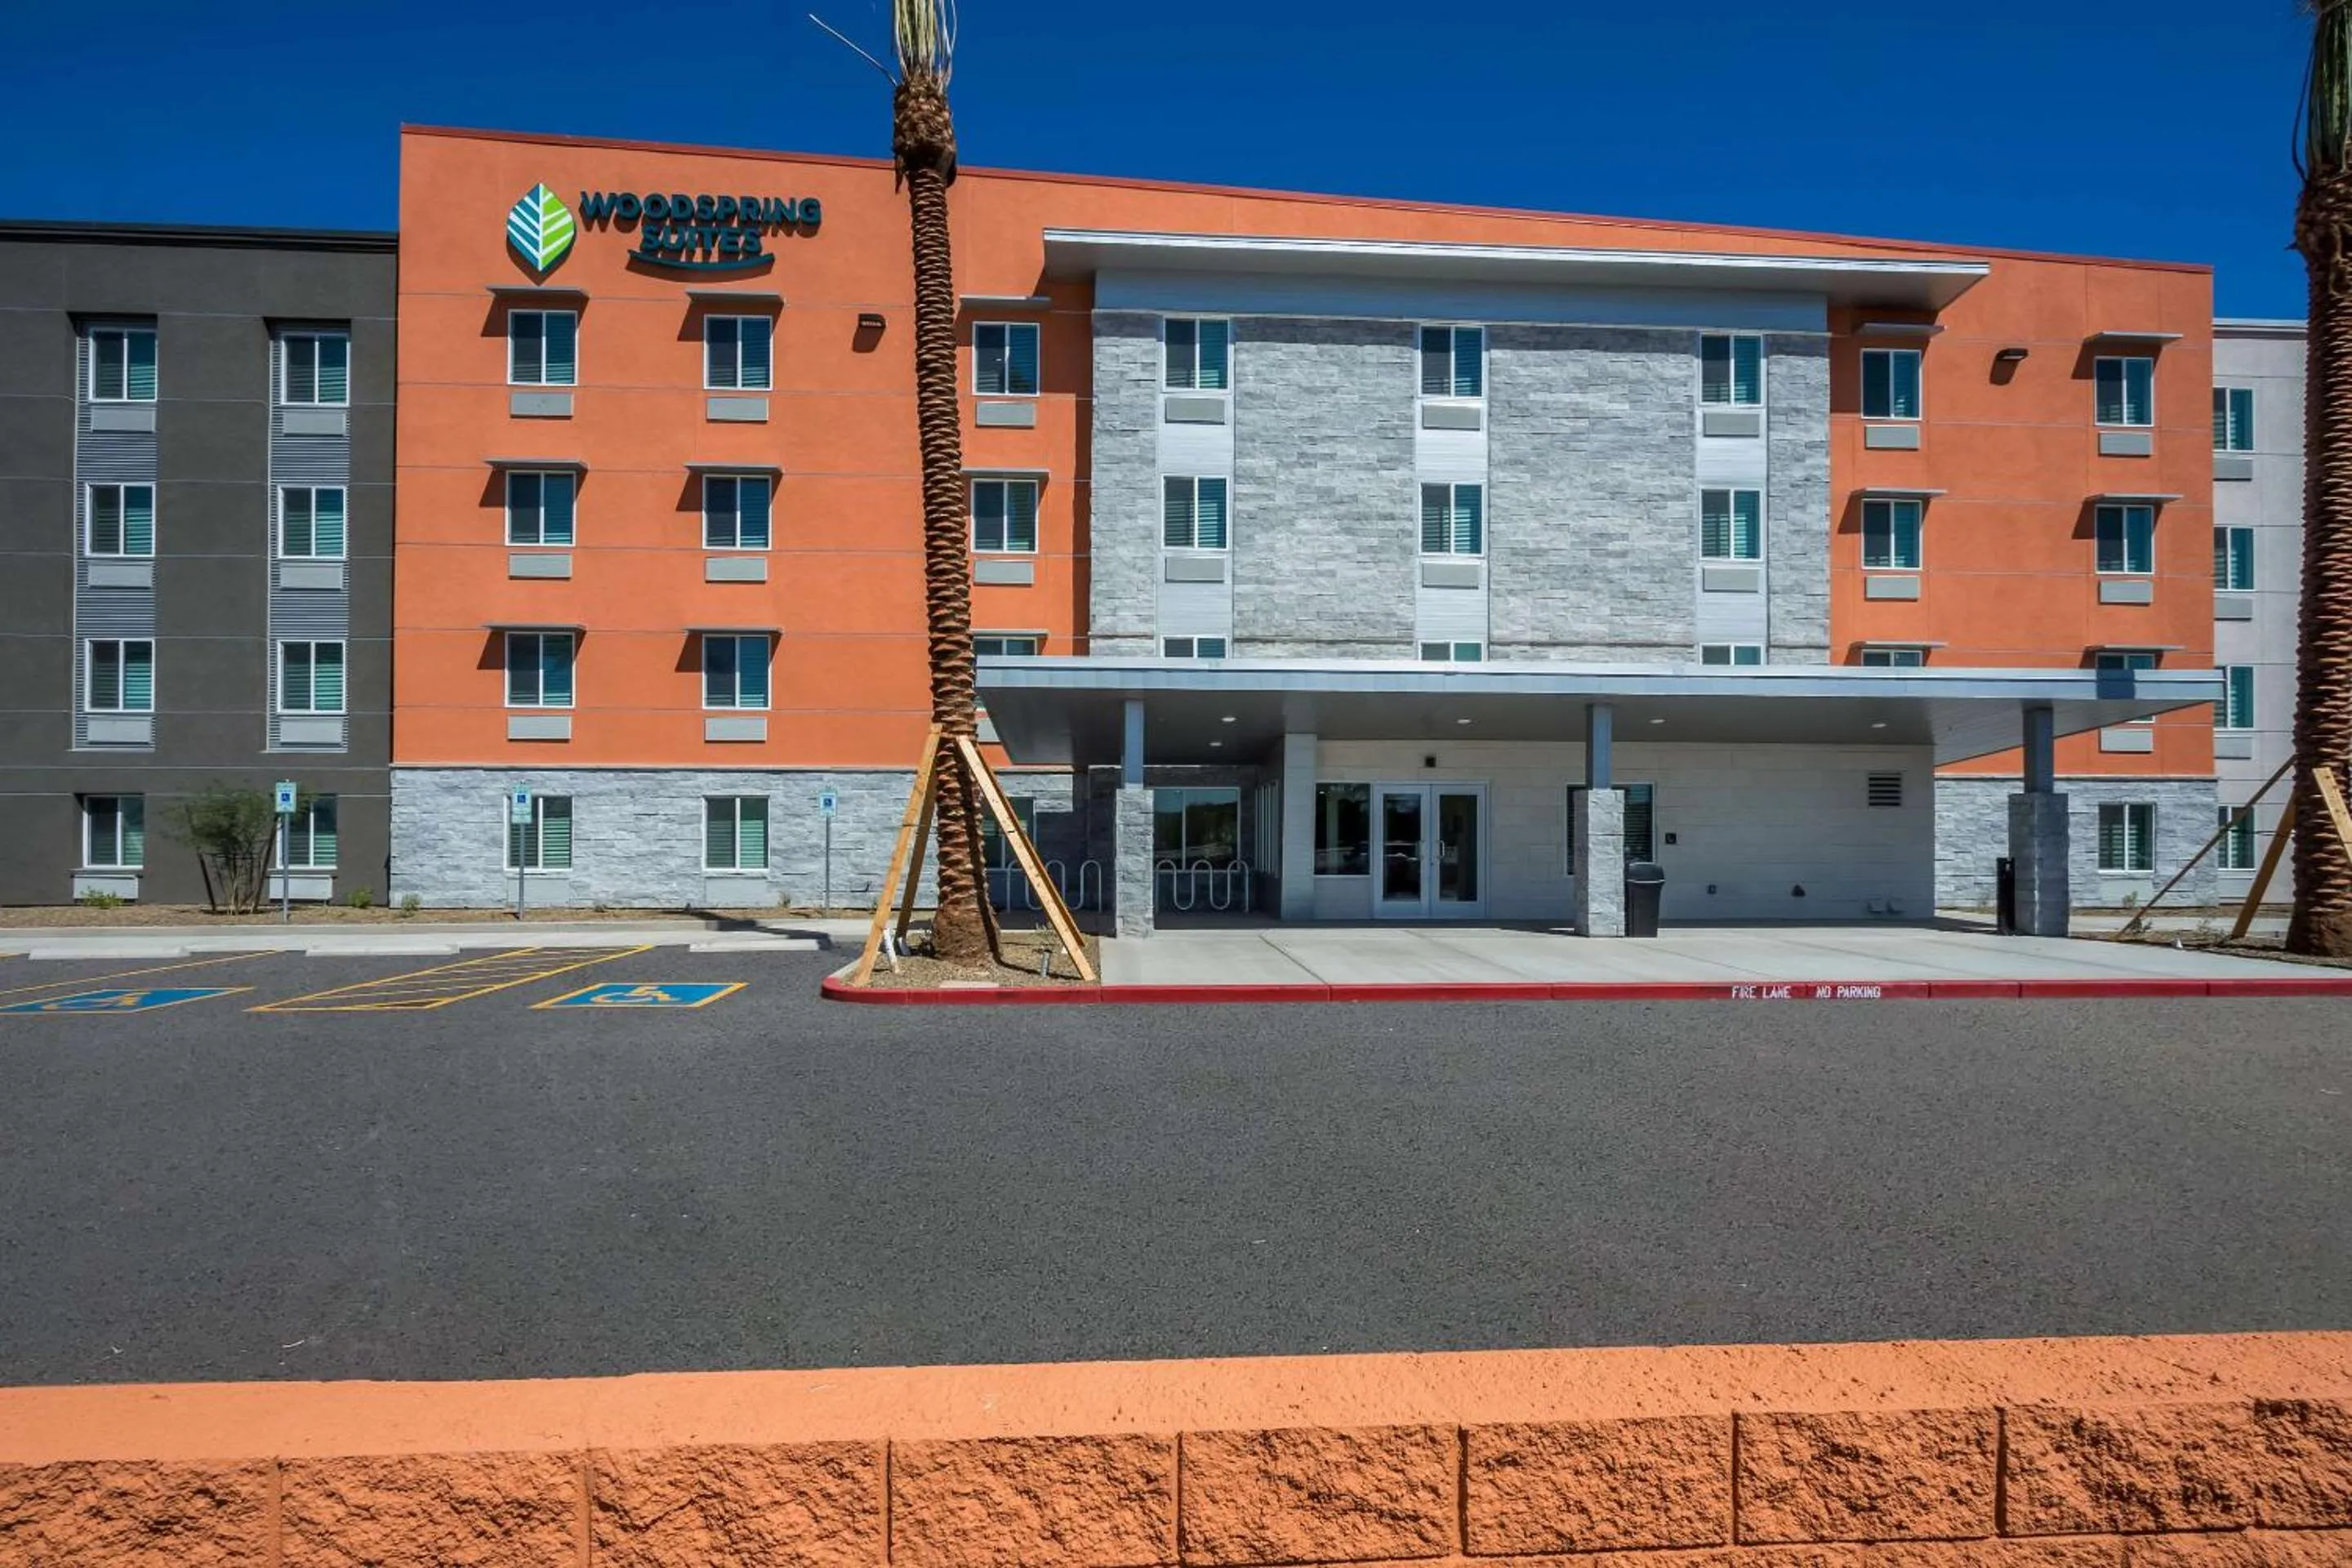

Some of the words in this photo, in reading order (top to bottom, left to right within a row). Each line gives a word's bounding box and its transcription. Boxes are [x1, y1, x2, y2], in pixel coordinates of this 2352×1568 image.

[580, 190, 822, 224] WOODSPRING
[639, 225, 764, 255] SUITES
[1731, 986, 1756, 999] FIRE
[1762, 986, 1792, 999] LANE
[1816, 986, 1831, 999] NO
[1837, 986, 1882, 999] PARKING
